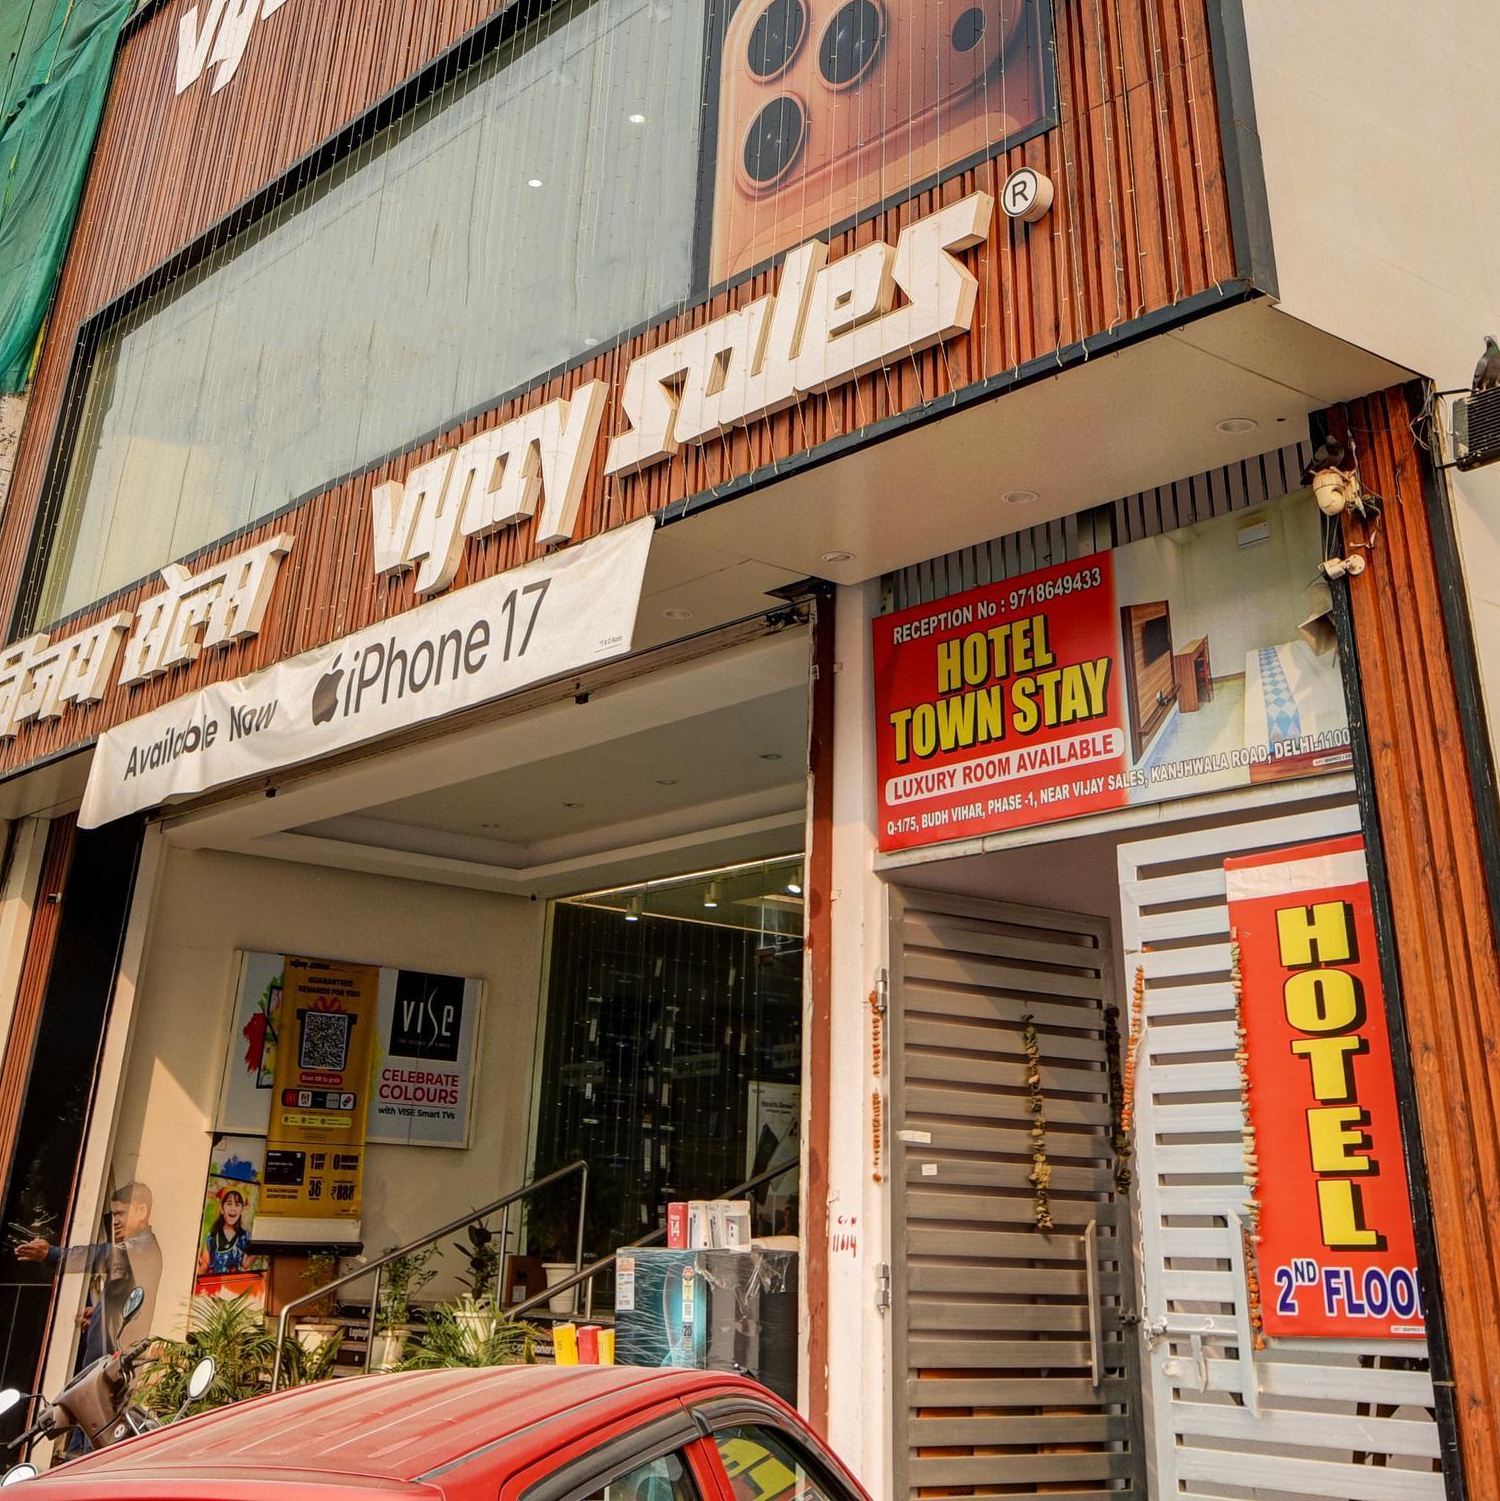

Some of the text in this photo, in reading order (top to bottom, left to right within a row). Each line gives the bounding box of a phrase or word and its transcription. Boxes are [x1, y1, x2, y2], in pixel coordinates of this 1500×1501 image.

[373, 379, 607, 595] vijay
[604, 190, 994, 478] sales
[118, 531, 295, 687] सेल्स
[893, 604, 973, 645] RECEPTION
[977, 600, 997, 620] No
[1009, 567, 1101, 610] 9718649433
[123, 577, 553, 782] Available Now iPhone 17
[936, 614, 1056, 696] HOTEL
[890, 657, 1112, 764] TOWN STAY
[894, 733, 1114, 801] LUXURY ROOM AVAILABLE
[921, 809, 949, 829] BUDH
[950, 802, 986, 823] VIHAR,
[988, 793, 1023, 814] PHASE
[1040, 785, 1070, 805] NEAR
[1072, 776, 1105, 797] VIJAY
[1107, 770, 1148, 791] SALES,
[1151, 756, 1230, 784] KANJHWALA
[1231, 744, 1272, 767] ROAD,
[378, 1105, 456, 1120] with VISE Smart TVs
[379, 1083, 459, 1106] COLOURS
[382, 1068, 459, 1088] CELEBRATE
[1275, 900, 1387, 1253] HOTEL
[1275, 1258, 1318, 1315] 2ND
